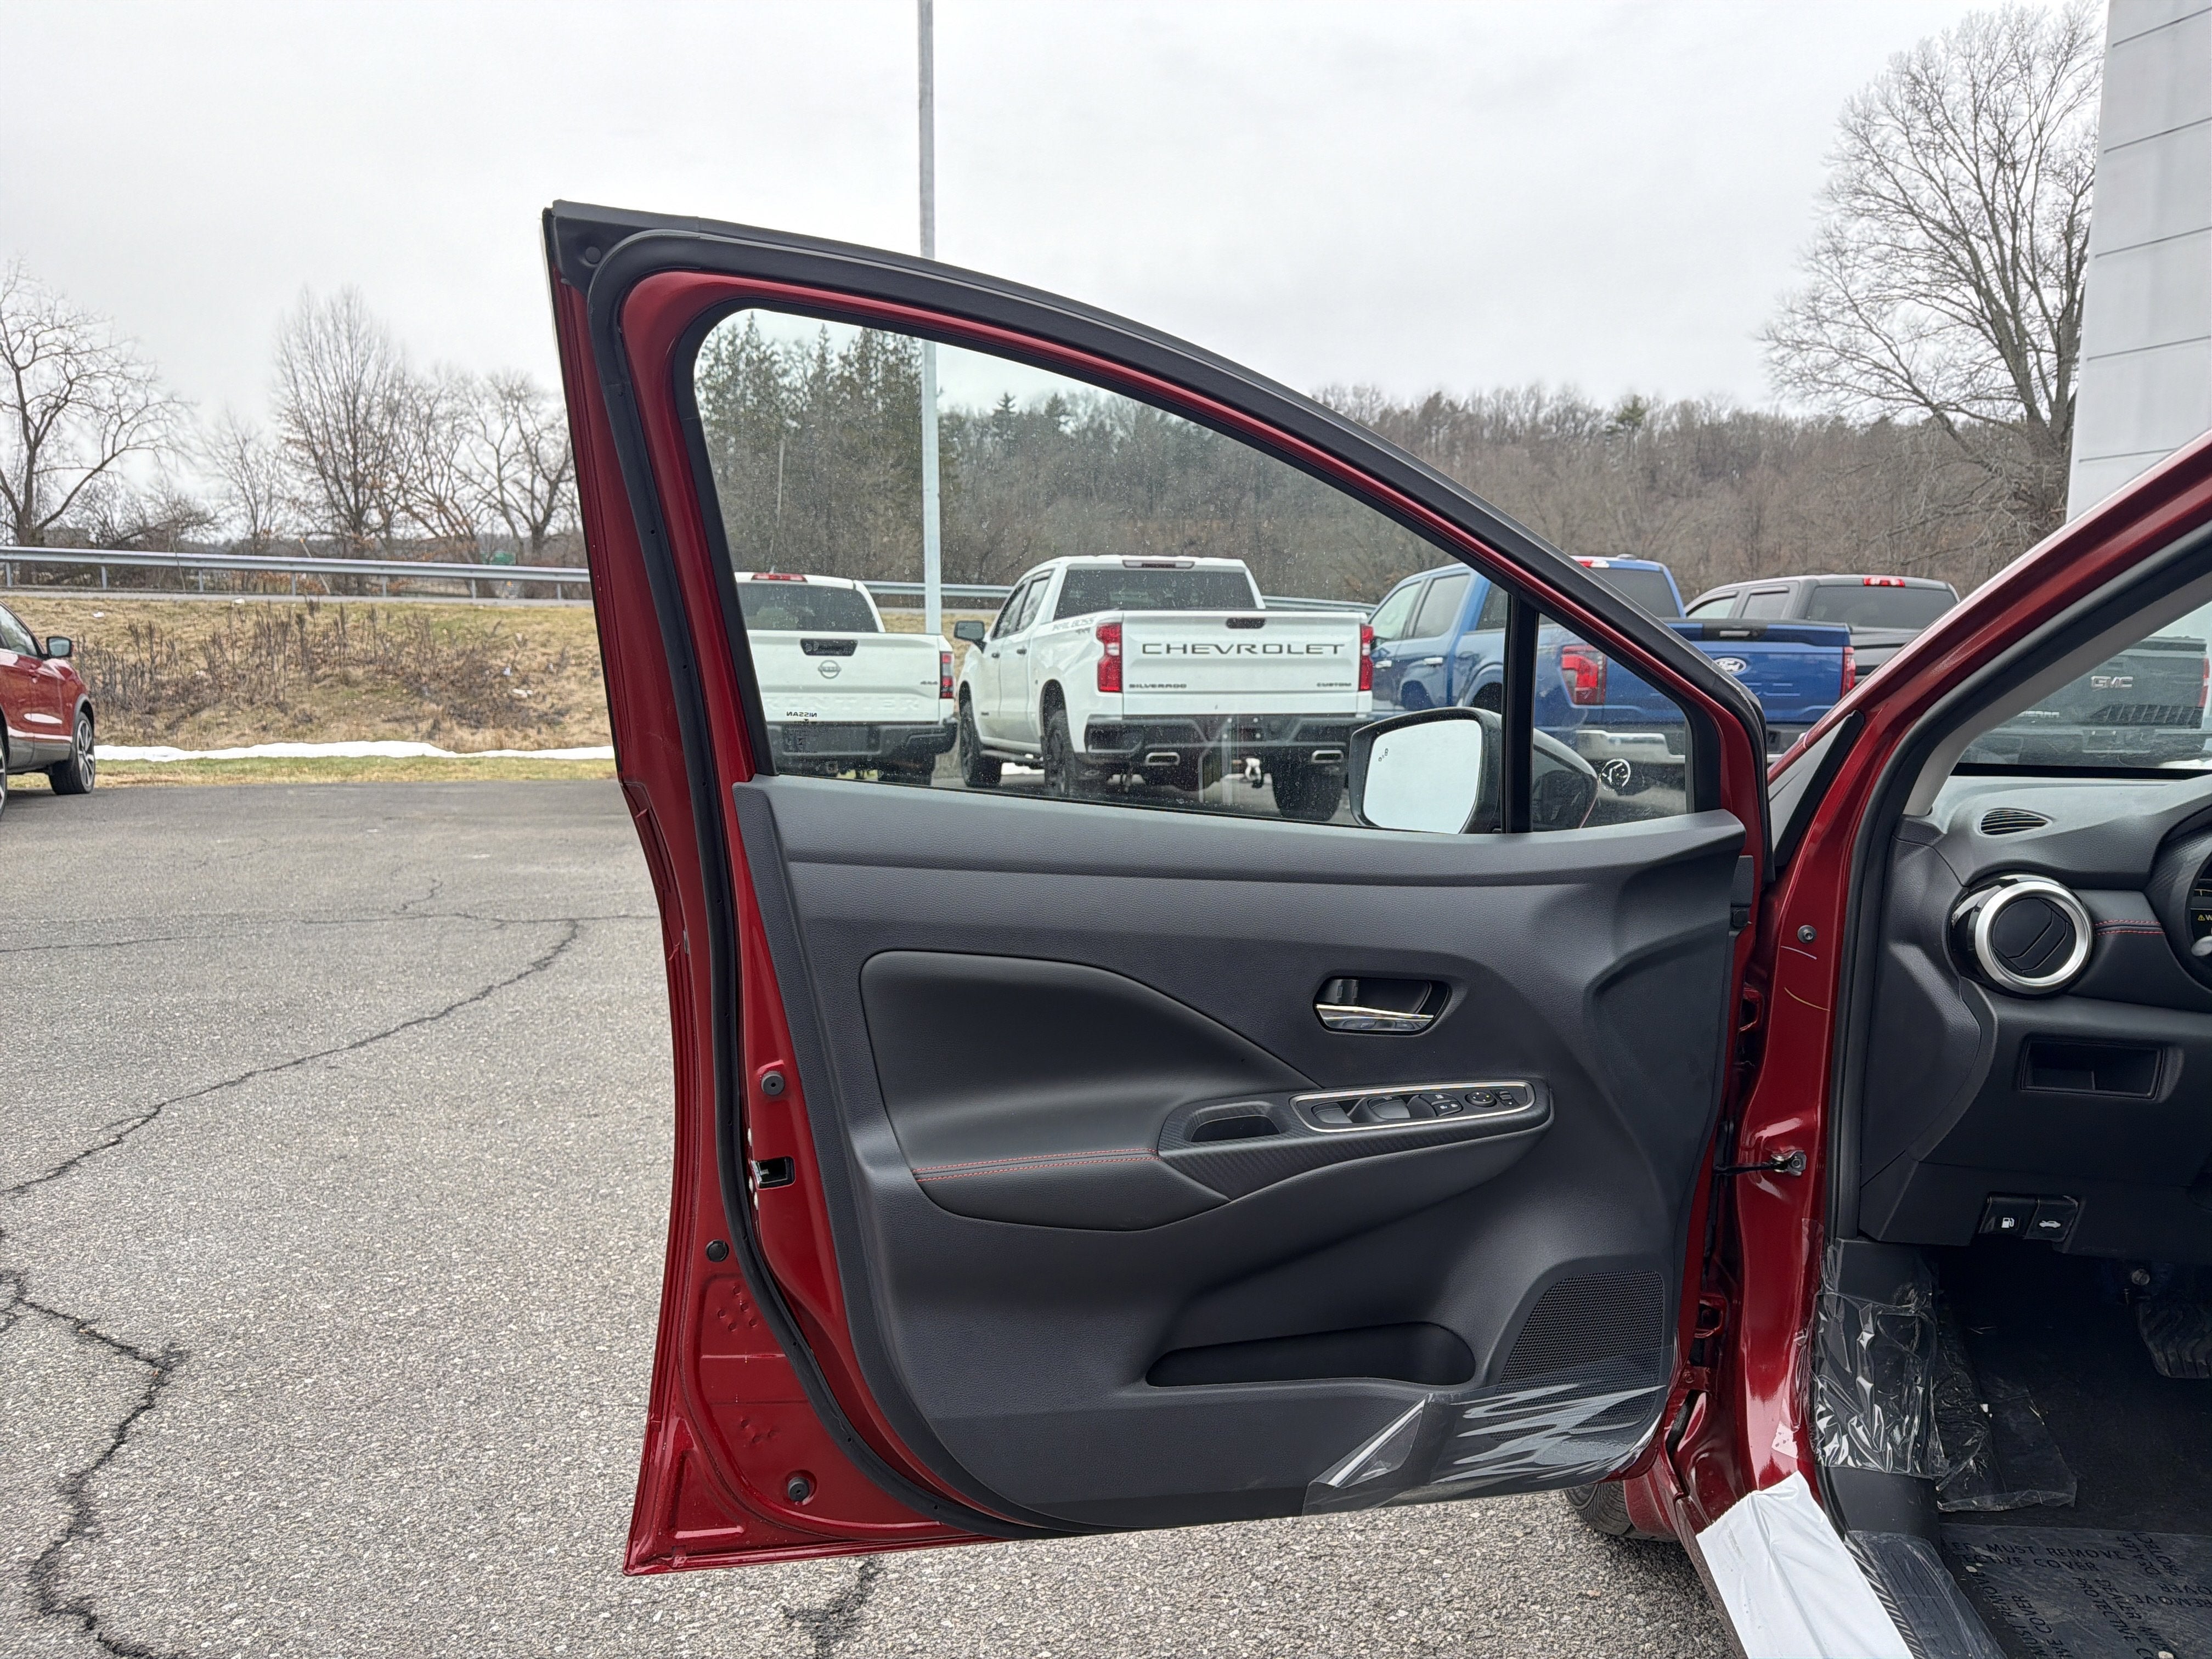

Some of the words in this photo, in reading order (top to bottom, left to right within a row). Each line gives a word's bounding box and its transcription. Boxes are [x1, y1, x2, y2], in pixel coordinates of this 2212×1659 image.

[1142, 643, 1345, 654] CHEVROLET
[2091, 675, 2134, 689] GMC
[1986, 1543, 2035, 1555] MUST
[2046, 1548, 2130, 1561] REMOVE
[1954, 1554, 2026, 1566] TECTIVE
[2034, 1558, 2101, 1571] COVER
[2156, 1583, 2212, 1595] OVER
[2094, 1579, 2143, 1620] DEALER
[2012, 1595, 2052, 1633] COVER
